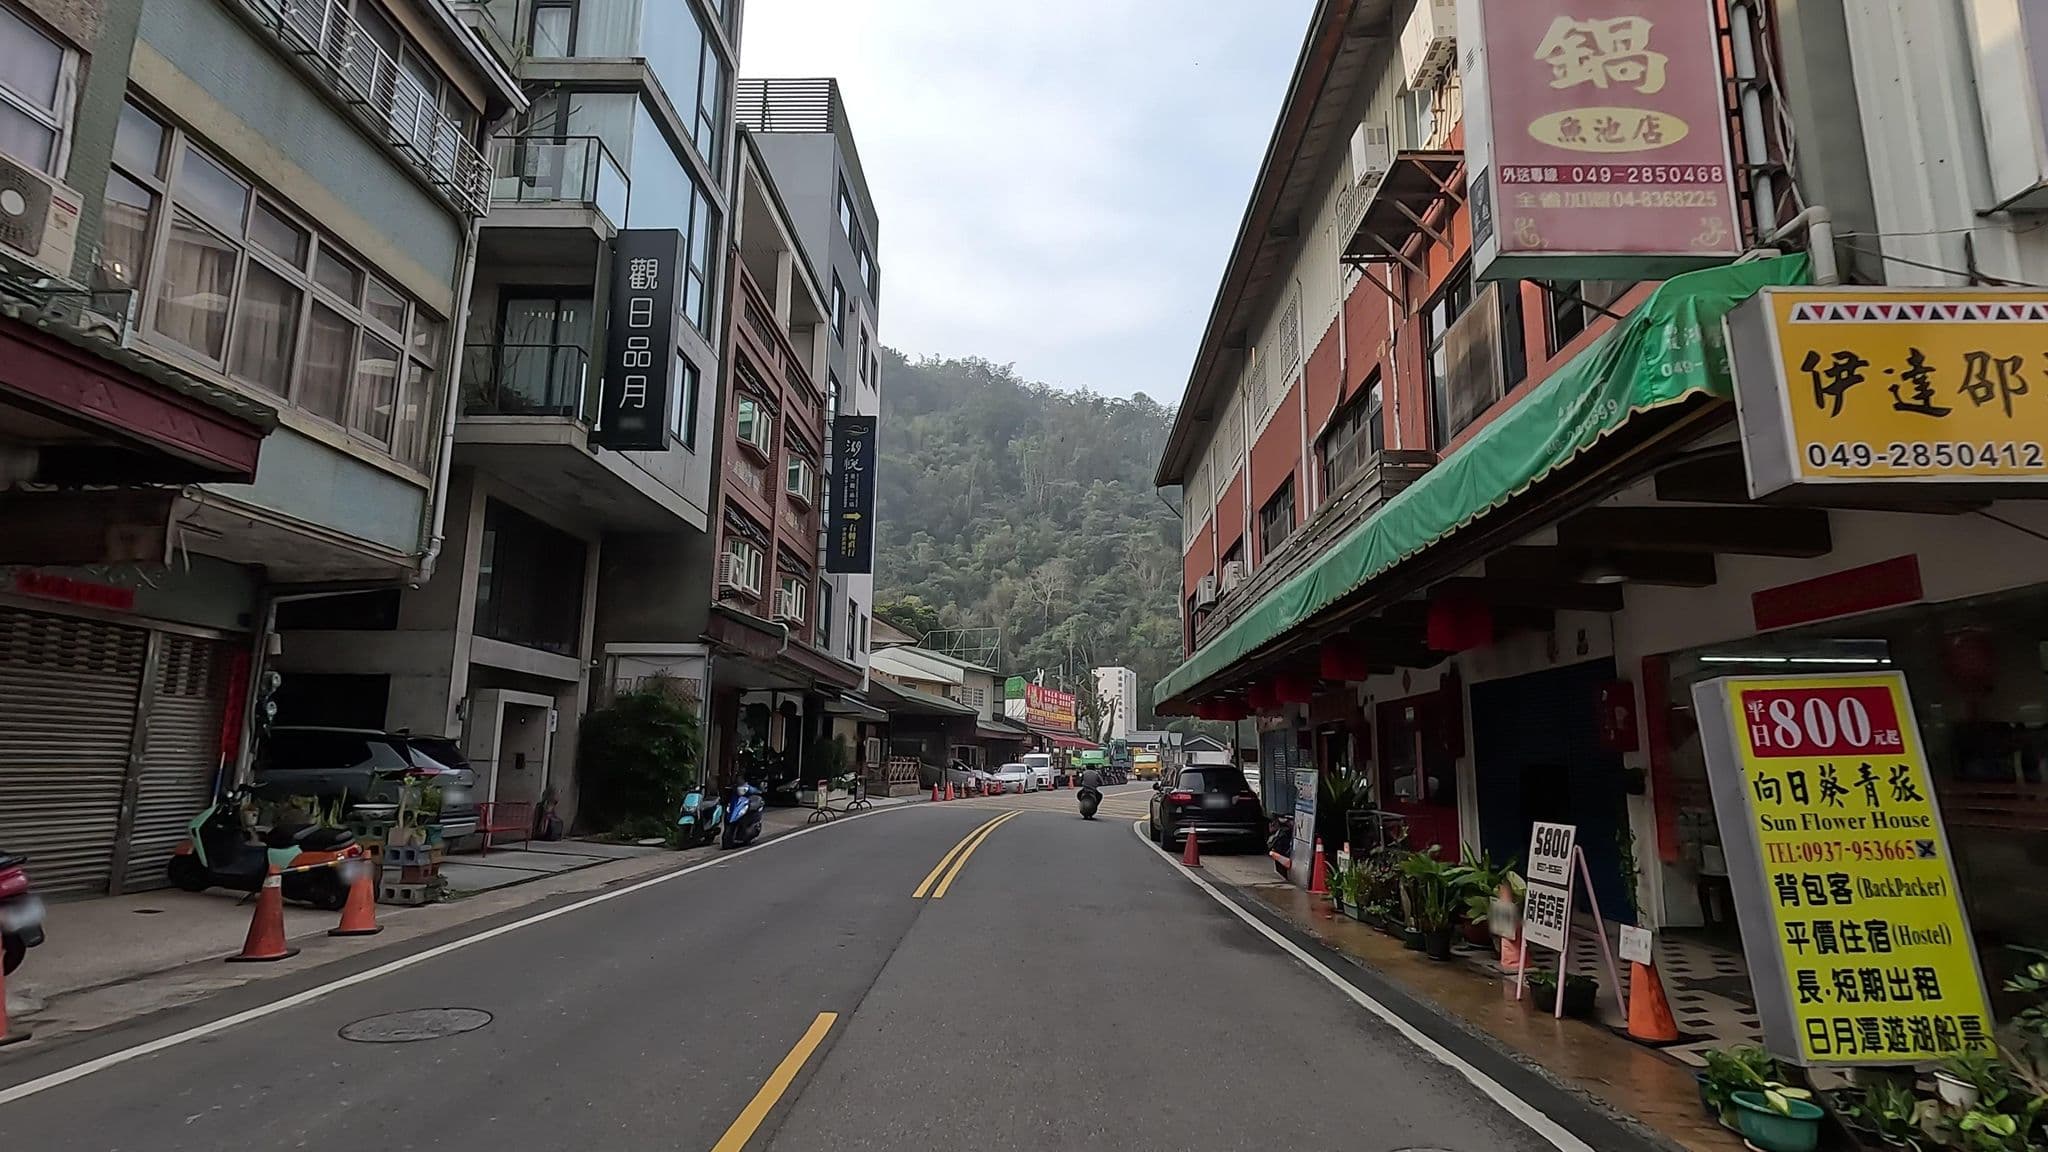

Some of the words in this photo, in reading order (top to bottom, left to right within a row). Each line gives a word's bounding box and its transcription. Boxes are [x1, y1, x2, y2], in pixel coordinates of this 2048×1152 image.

[1534, 15, 1669, 94] 鍋
[1557, 115, 1664, 144] 魚池店
[1572, 166, 1723, 183] 049-2850468
[619, 258, 659, 409] 觀日品月
[1800, 347, 2048, 419] 伊達邵
[1807, 443, 2044, 468] 049-2850412
[1747, 700, 1770, 748] 平日
[1768, 696, 1873, 749] 800
[1752, 762, 1925, 809] 向日葵青旅
[1761, 813, 1797, 832] Sun
[1800, 811, 1867, 831] Flower
[1871, 810, 1931, 830] House
[1775, 872, 1854, 907] 背包客
[1857, 875, 1947, 900] (BackPacker)
[1784, 919, 1892, 955] 平價住宿
[1892, 922, 1953, 947] (Hostel)
[1806, 1014, 1989, 1056] 日月潭遊湖船票
